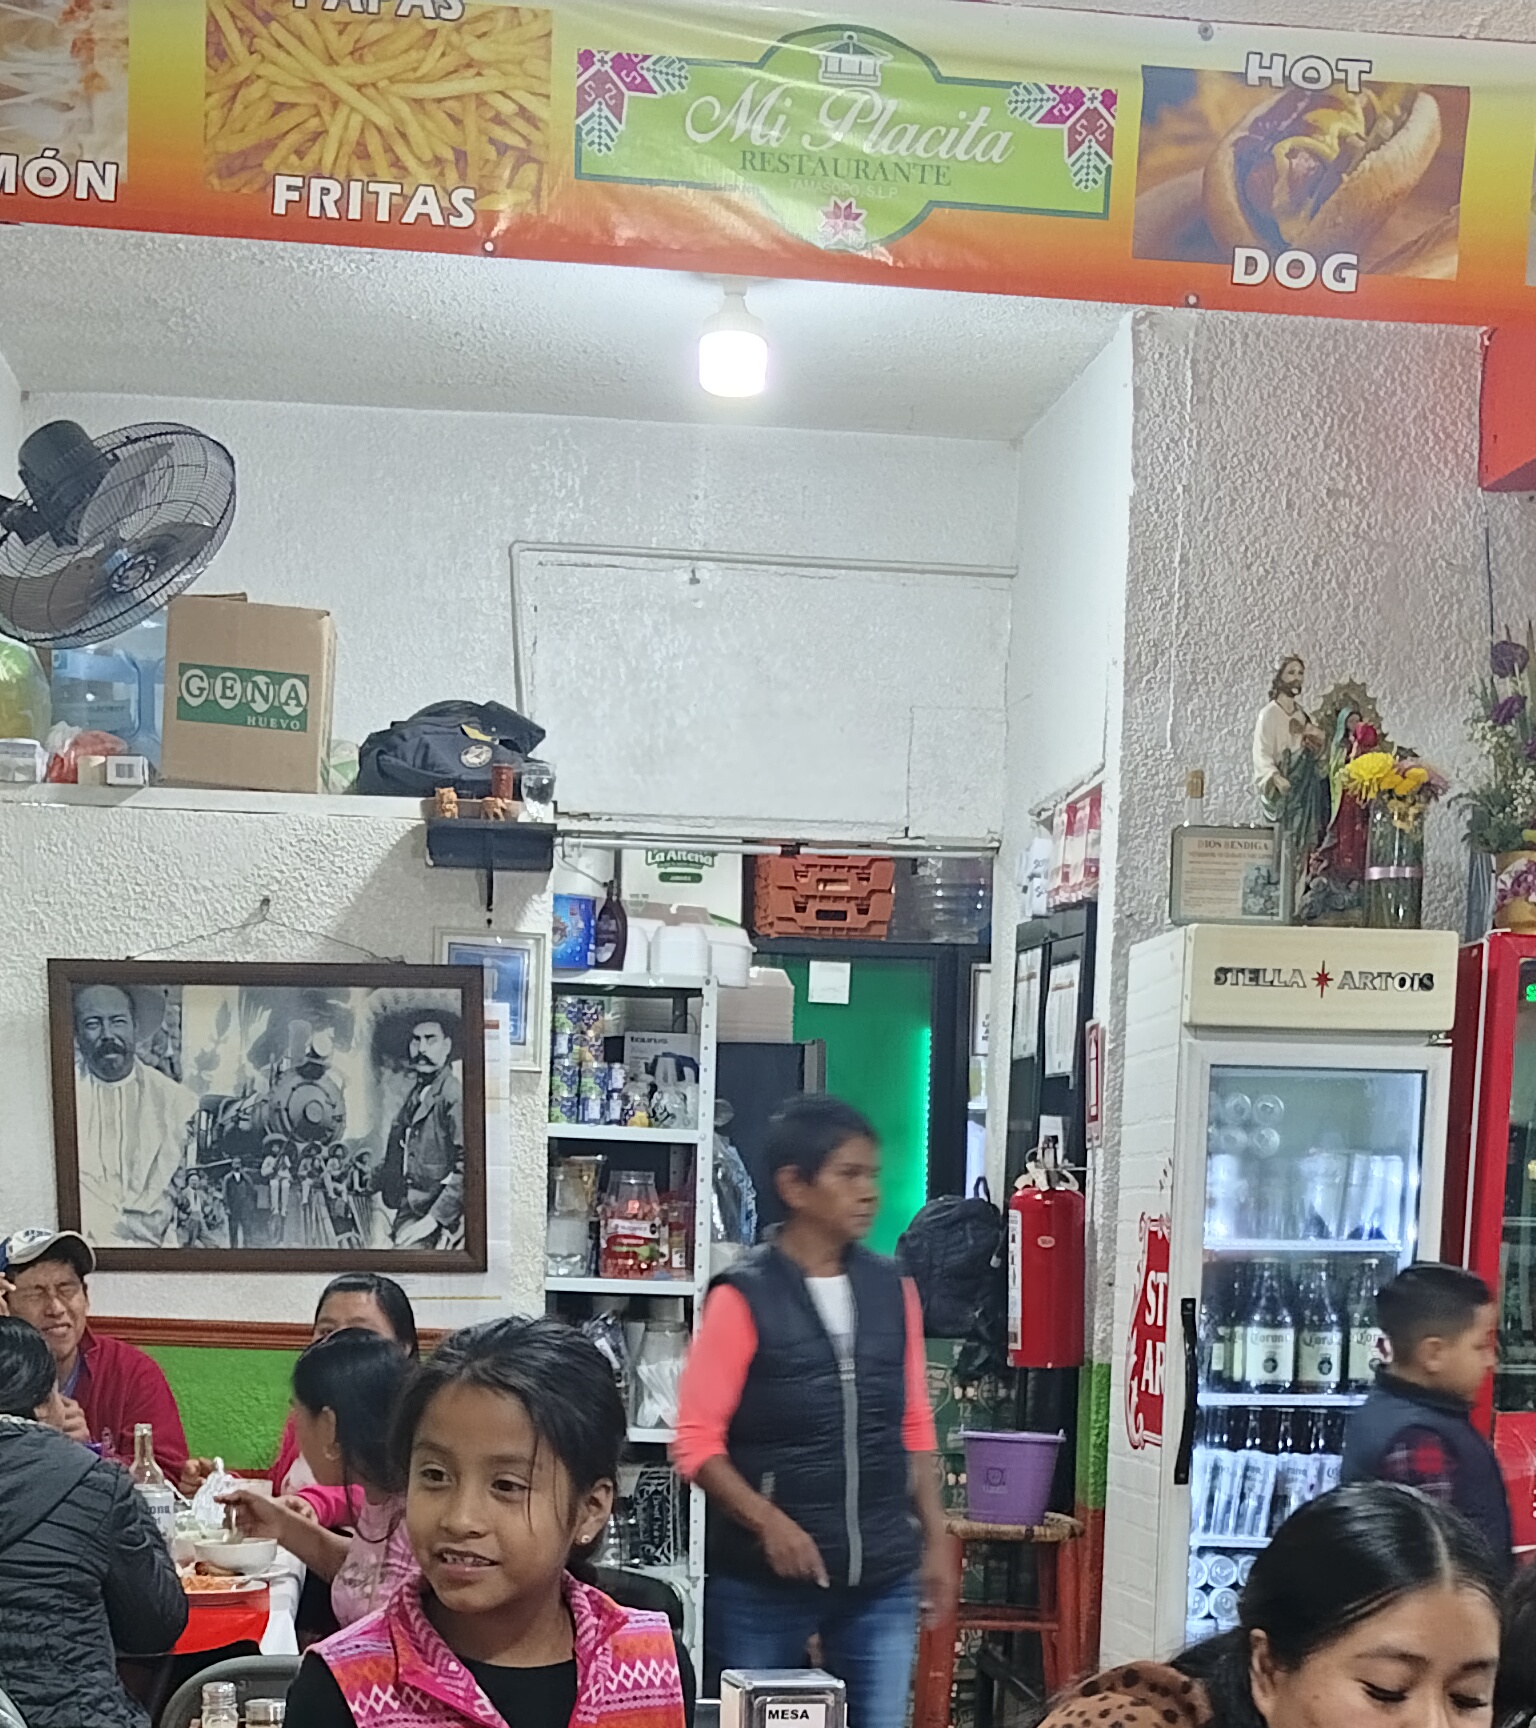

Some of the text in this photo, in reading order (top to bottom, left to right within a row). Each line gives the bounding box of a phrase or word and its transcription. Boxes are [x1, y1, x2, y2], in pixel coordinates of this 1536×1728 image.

[1244, 50, 1373, 95] HOT
[683, 78, 1017, 165] Mi Placita
[738, 148, 953, 189] RESTAURANTE
[270, 173, 478, 231] FRITAS
[1230, 245, 1360, 294] DOG
[182, 666, 308, 717] GENA
[246, 715, 302, 731] HUEVO
[1197, 839, 1269, 851] DIOS BENDIGA
[1213, 965, 1436, 993] STELLA ARTOIS
[766, 1708, 811, 1721] MESA
